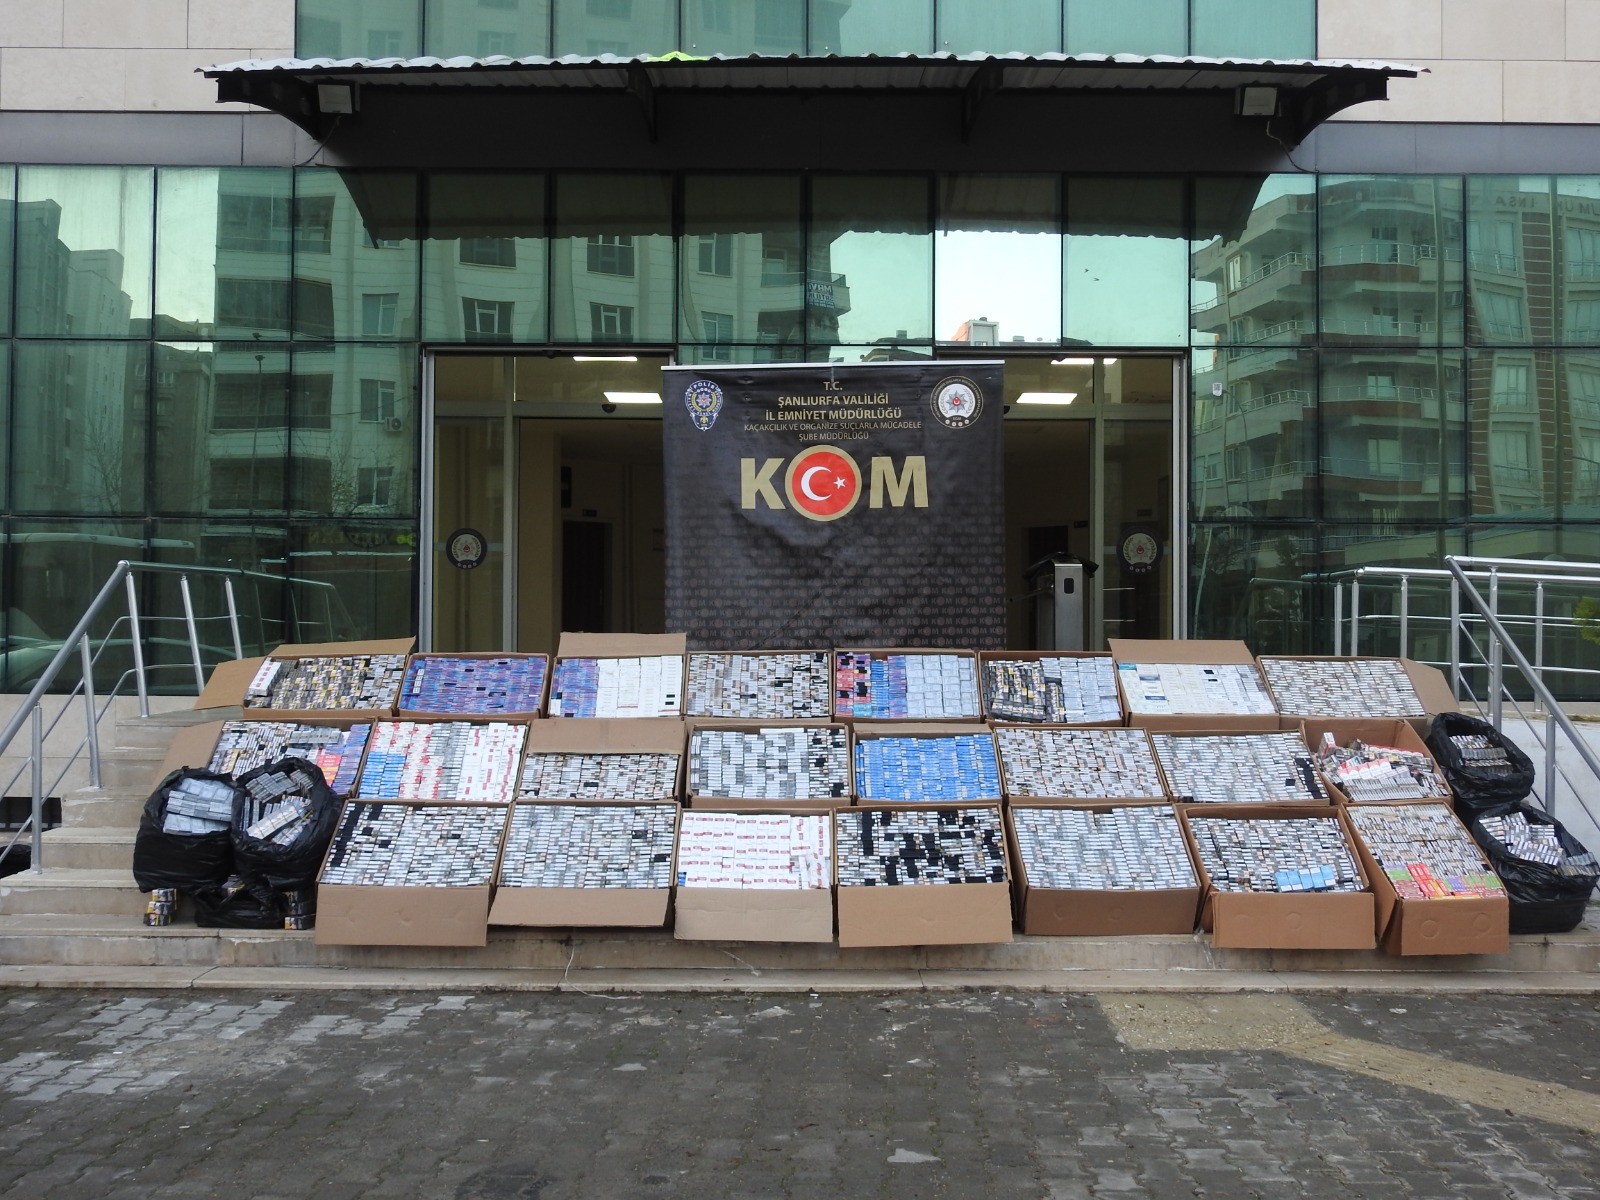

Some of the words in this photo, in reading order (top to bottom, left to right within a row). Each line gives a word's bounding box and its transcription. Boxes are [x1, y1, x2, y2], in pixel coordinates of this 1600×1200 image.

[823, 381, 843, 391] T.C.
[777, 396, 840, 408] ŞANLIURFA
[843, 393, 889, 405] VALİLİĞİ
[765, 409, 776, 421] İL
[777, 408, 827, 420] EMNİYET
[828, 407, 902, 420] MÜDÜRLÜĞÜ
[744, 423, 788, 433] KAÇAKÇILIK
[788, 423, 799, 431] VE
[799, 421, 838, 431] ORGANİZE
[840, 422, 879, 431] SUÇLARLA
[880, 420, 922, 429] MÜCADELE
[798, 433, 818, 442] ŞUBE
[819, 431, 869, 441] MÜDÜRLÜĞÜ
[740, 445, 929, 522] KOM
